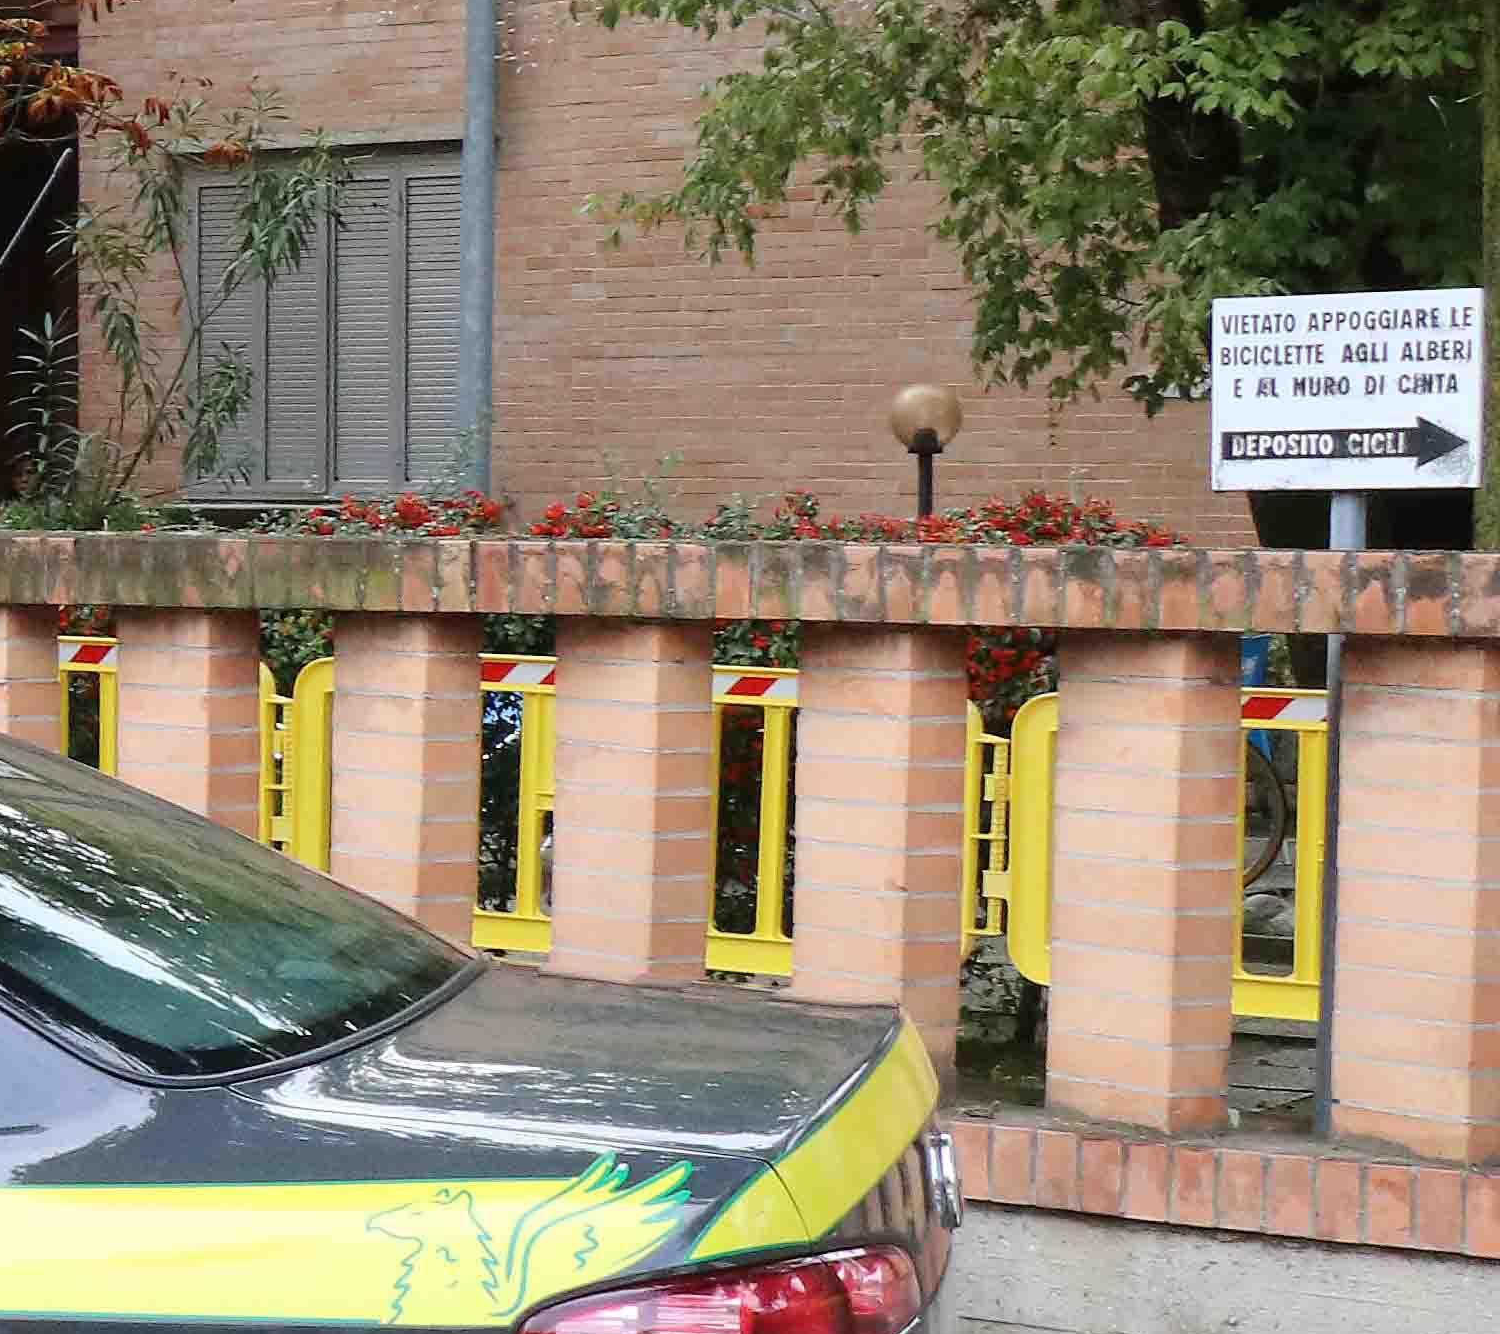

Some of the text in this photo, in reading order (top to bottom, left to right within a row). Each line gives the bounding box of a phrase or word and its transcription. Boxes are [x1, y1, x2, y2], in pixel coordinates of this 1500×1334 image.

[1221, 306, 1473, 335] VIETATO APPOGGIARE LE
[1220, 339, 1473, 366] BICICLETTE AGLI ALBERI
[1233, 378, 1242, 398] E
[1293, 376, 1351, 397] MURO
[1364, 375, 1385, 395] DI
[1397, 373, 1459, 395] CINTA
[1230, 431, 1405, 457] DEPOSITO CICLI
